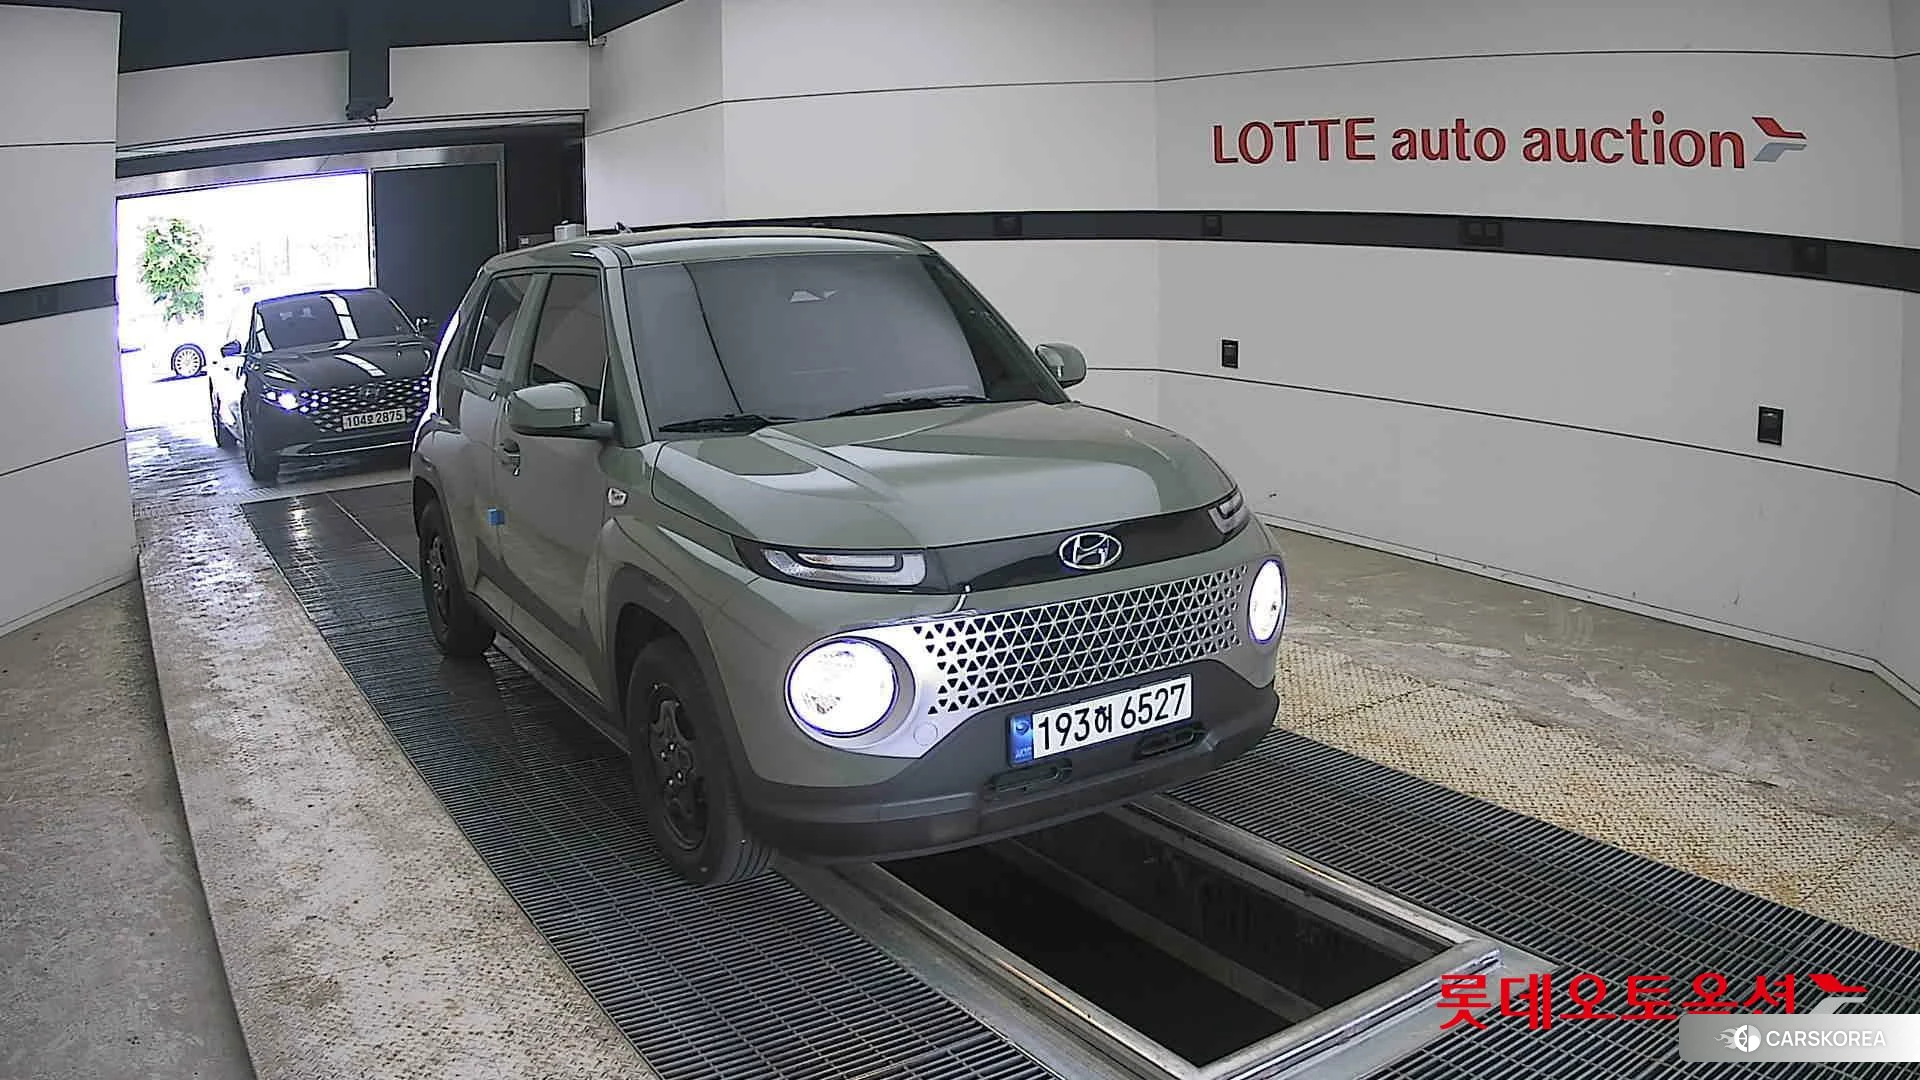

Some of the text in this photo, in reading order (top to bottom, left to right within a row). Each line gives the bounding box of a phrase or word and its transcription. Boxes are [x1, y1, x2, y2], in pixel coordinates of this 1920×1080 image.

[1213, 110, 1745, 169] LOTTE auto auction
[375, 410, 402, 424] 2875
[1038, 683, 1186, 750] 193허 6527
